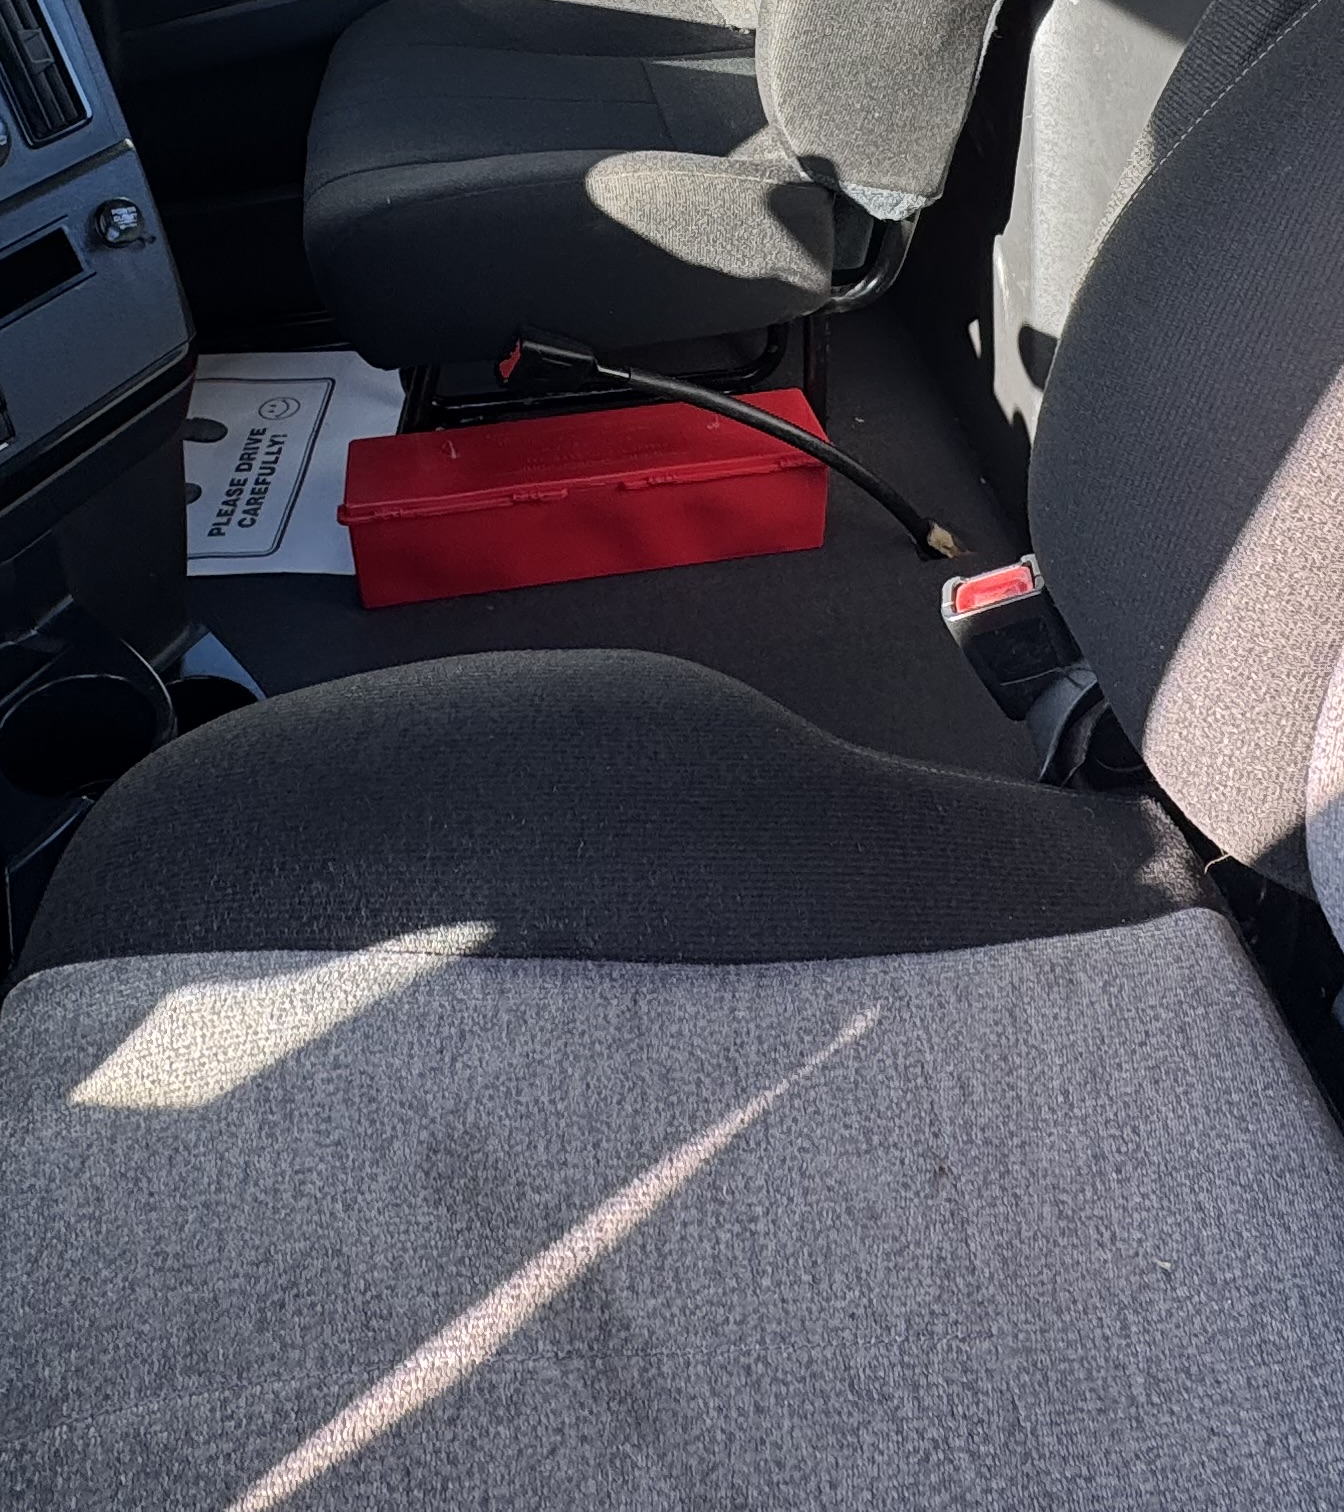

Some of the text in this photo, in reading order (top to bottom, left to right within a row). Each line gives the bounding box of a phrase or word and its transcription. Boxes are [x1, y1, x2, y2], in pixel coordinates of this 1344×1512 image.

[207, 428, 267, 537] PLEASE DRIVE
[237, 434, 288, 529] CAREFULLY!
